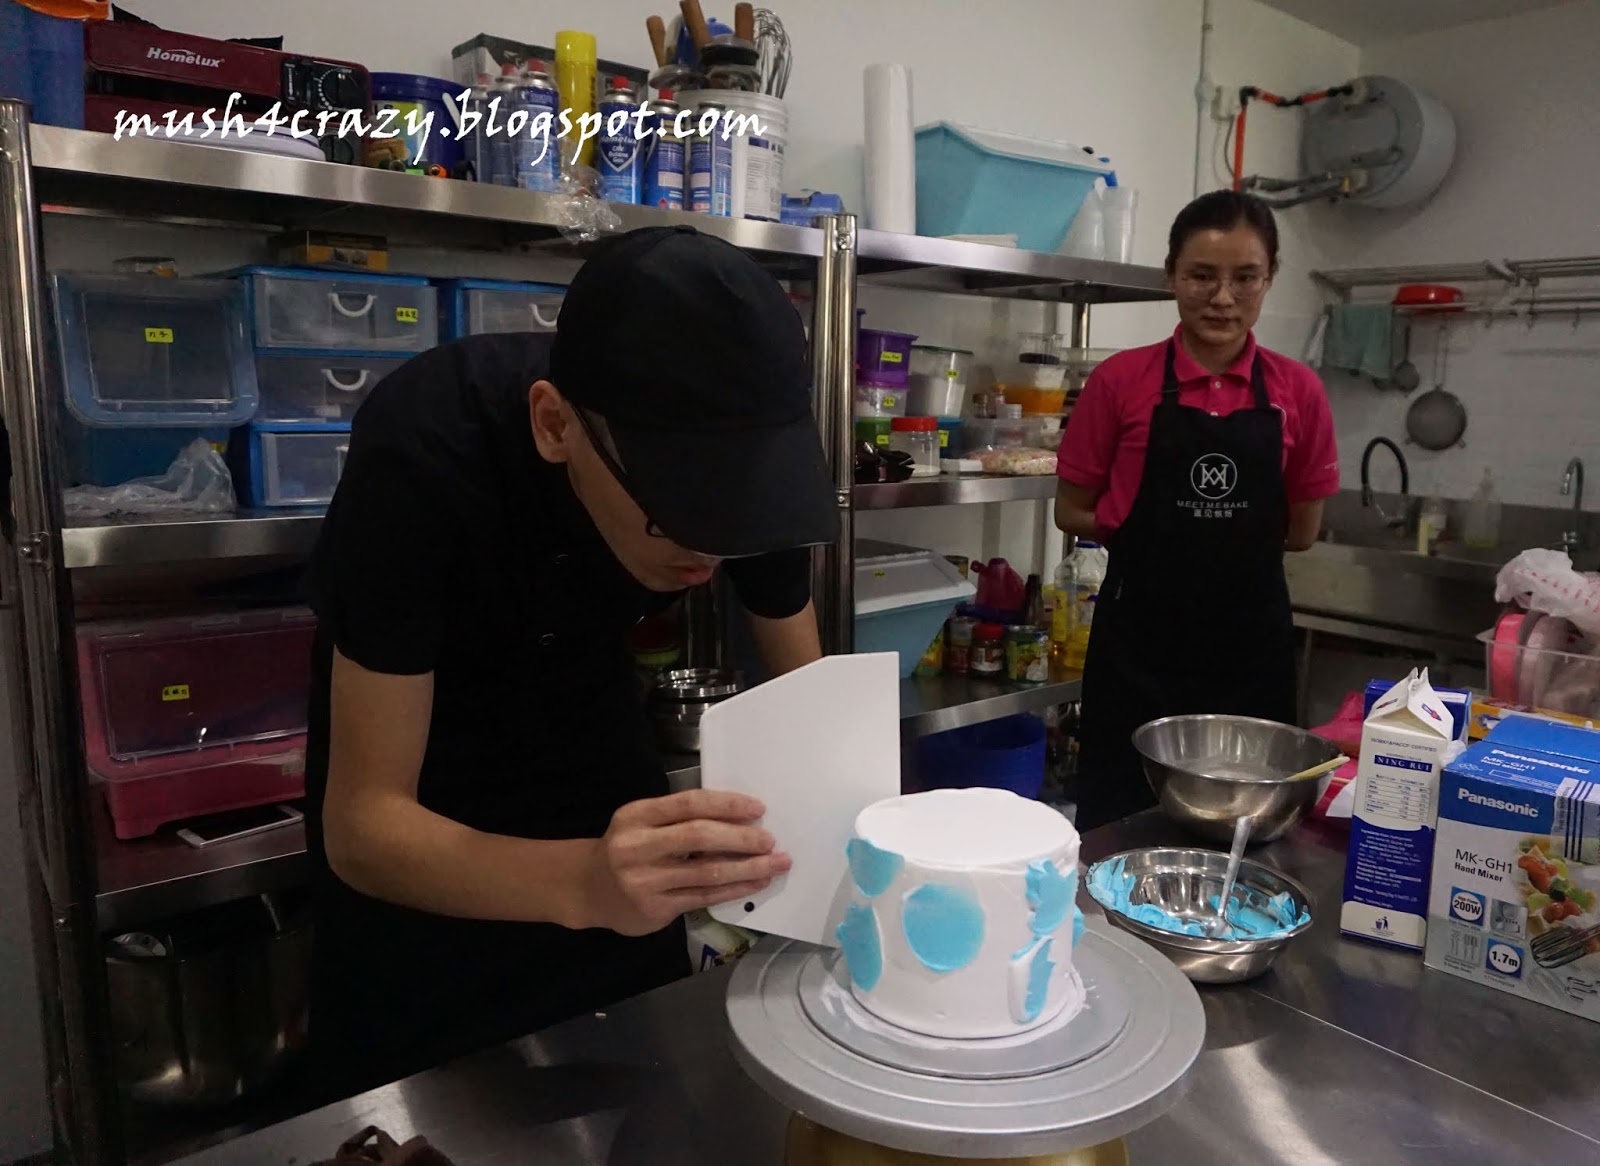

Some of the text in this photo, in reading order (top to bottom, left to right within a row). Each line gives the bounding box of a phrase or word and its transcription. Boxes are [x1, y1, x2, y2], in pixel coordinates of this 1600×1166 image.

[146, 47, 221, 67] Homelux
[1377, 757, 1405, 767] NING
[1409, 762, 1430, 771] RUI
[1483, 756, 1536, 770] MK-GH1
[1491, 749, 1591, 774] Panasonic
[1457, 787, 1539, 818] Panasonic
[1455, 849, 1513, 874] MK-GH1
[1454, 862, 1503, 882] Hand Mixer
[1454, 899, 1481, 915] 200W
[1492, 951, 1518, 967] 1.7m
